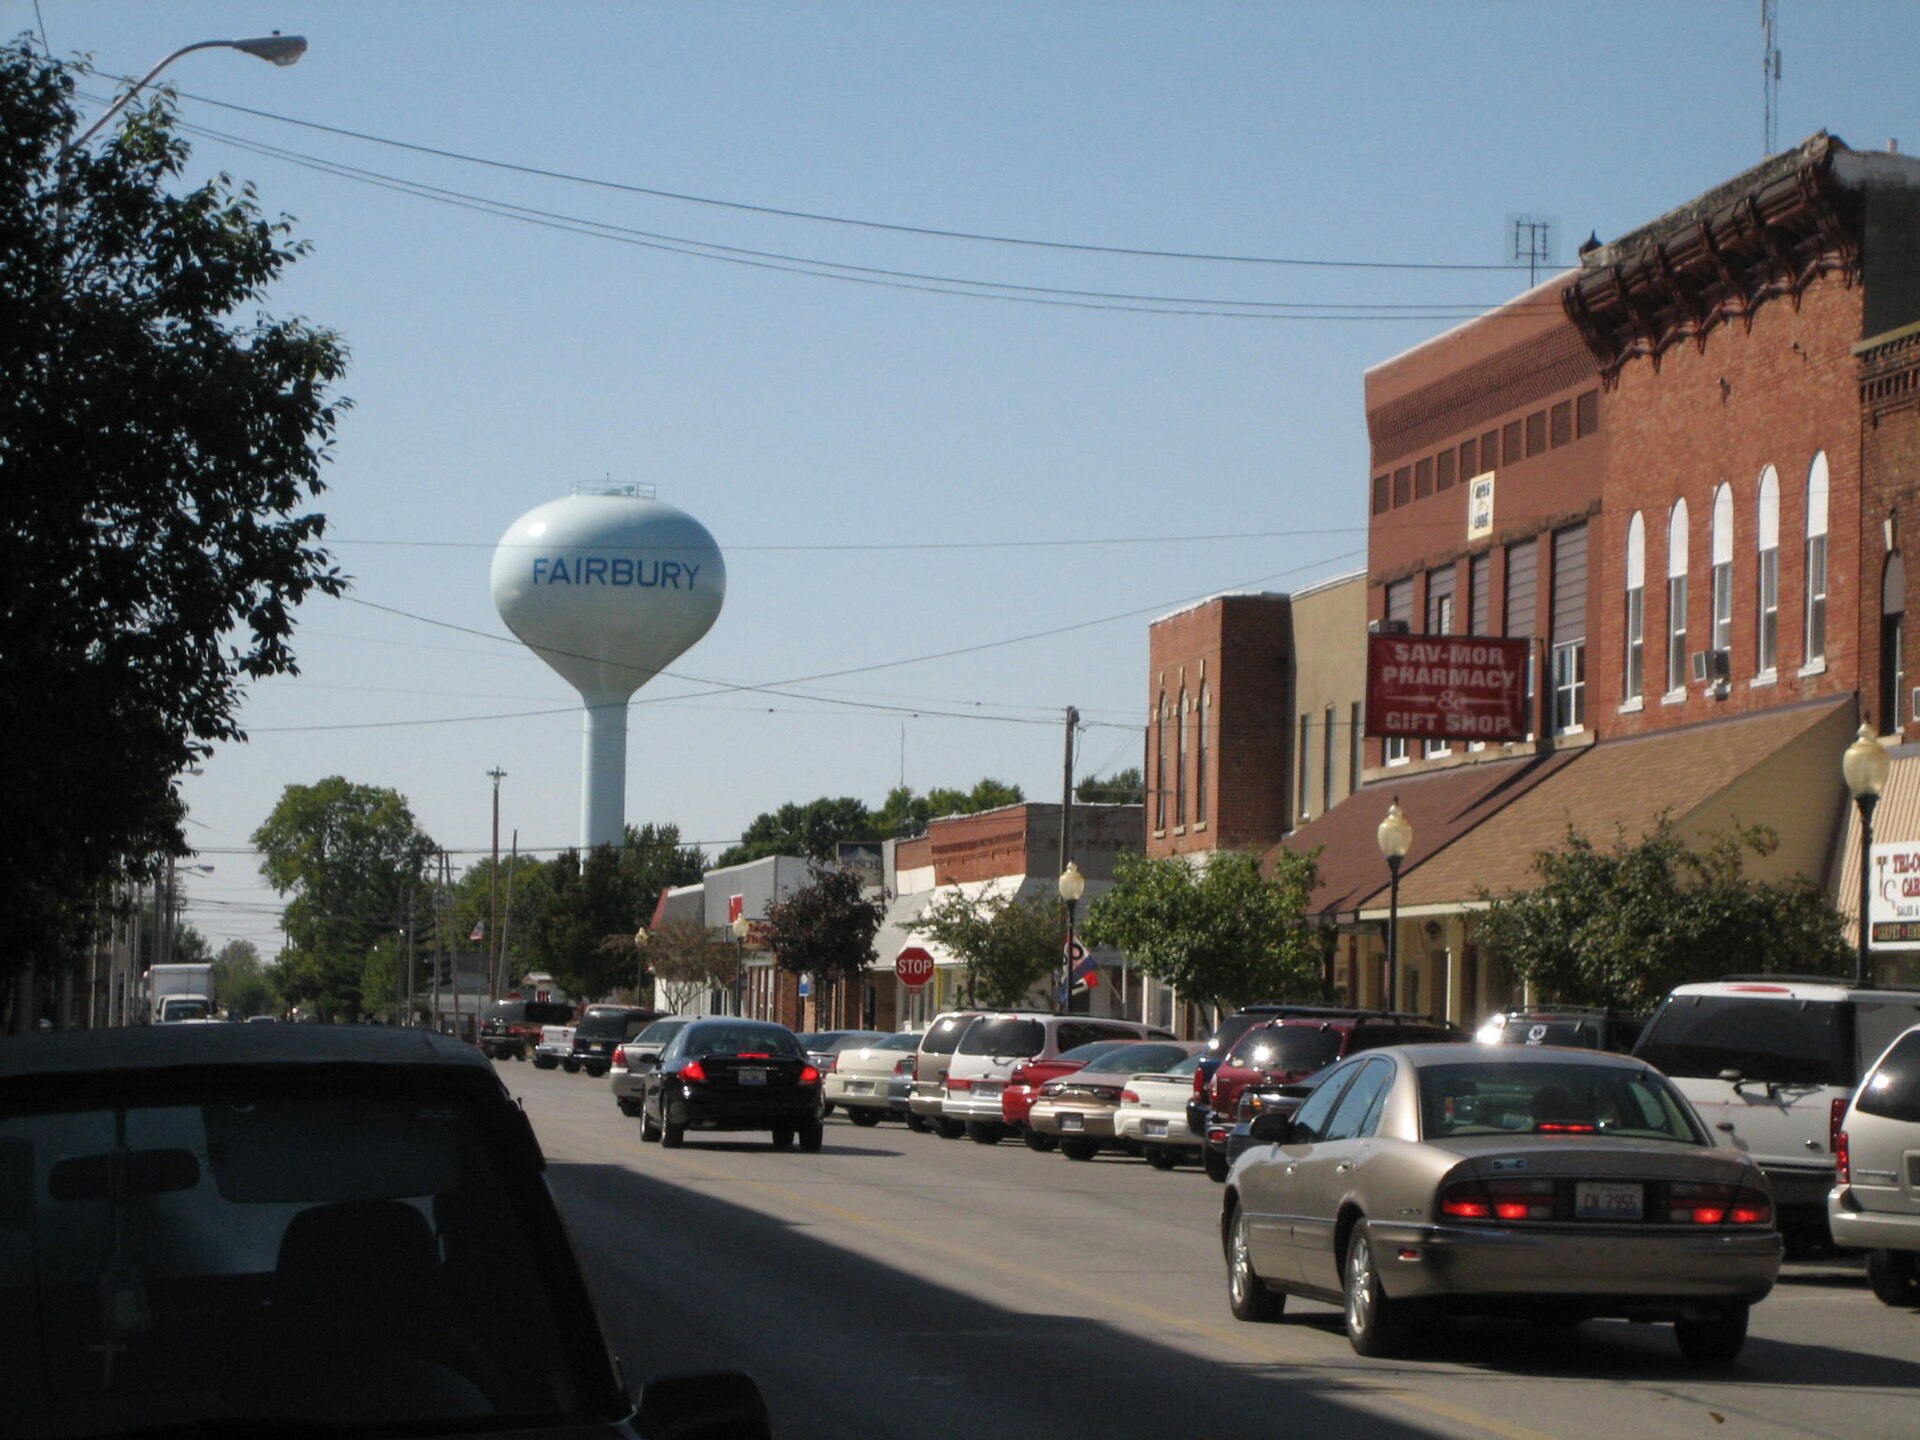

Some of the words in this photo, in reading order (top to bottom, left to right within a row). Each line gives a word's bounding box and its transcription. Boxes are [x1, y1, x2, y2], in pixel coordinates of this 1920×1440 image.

[532, 557, 701, 590] FAIRBURY
[1395, 643, 1504, 665] SAV-MOR
[1382, 665, 1515, 689] PHARMACY
[1437, 689, 1467, 710] &
[1385, 711, 1438, 730] GIFT
[1445, 713, 1512, 734] SHOP
[898, 959, 932, 975] STOP
